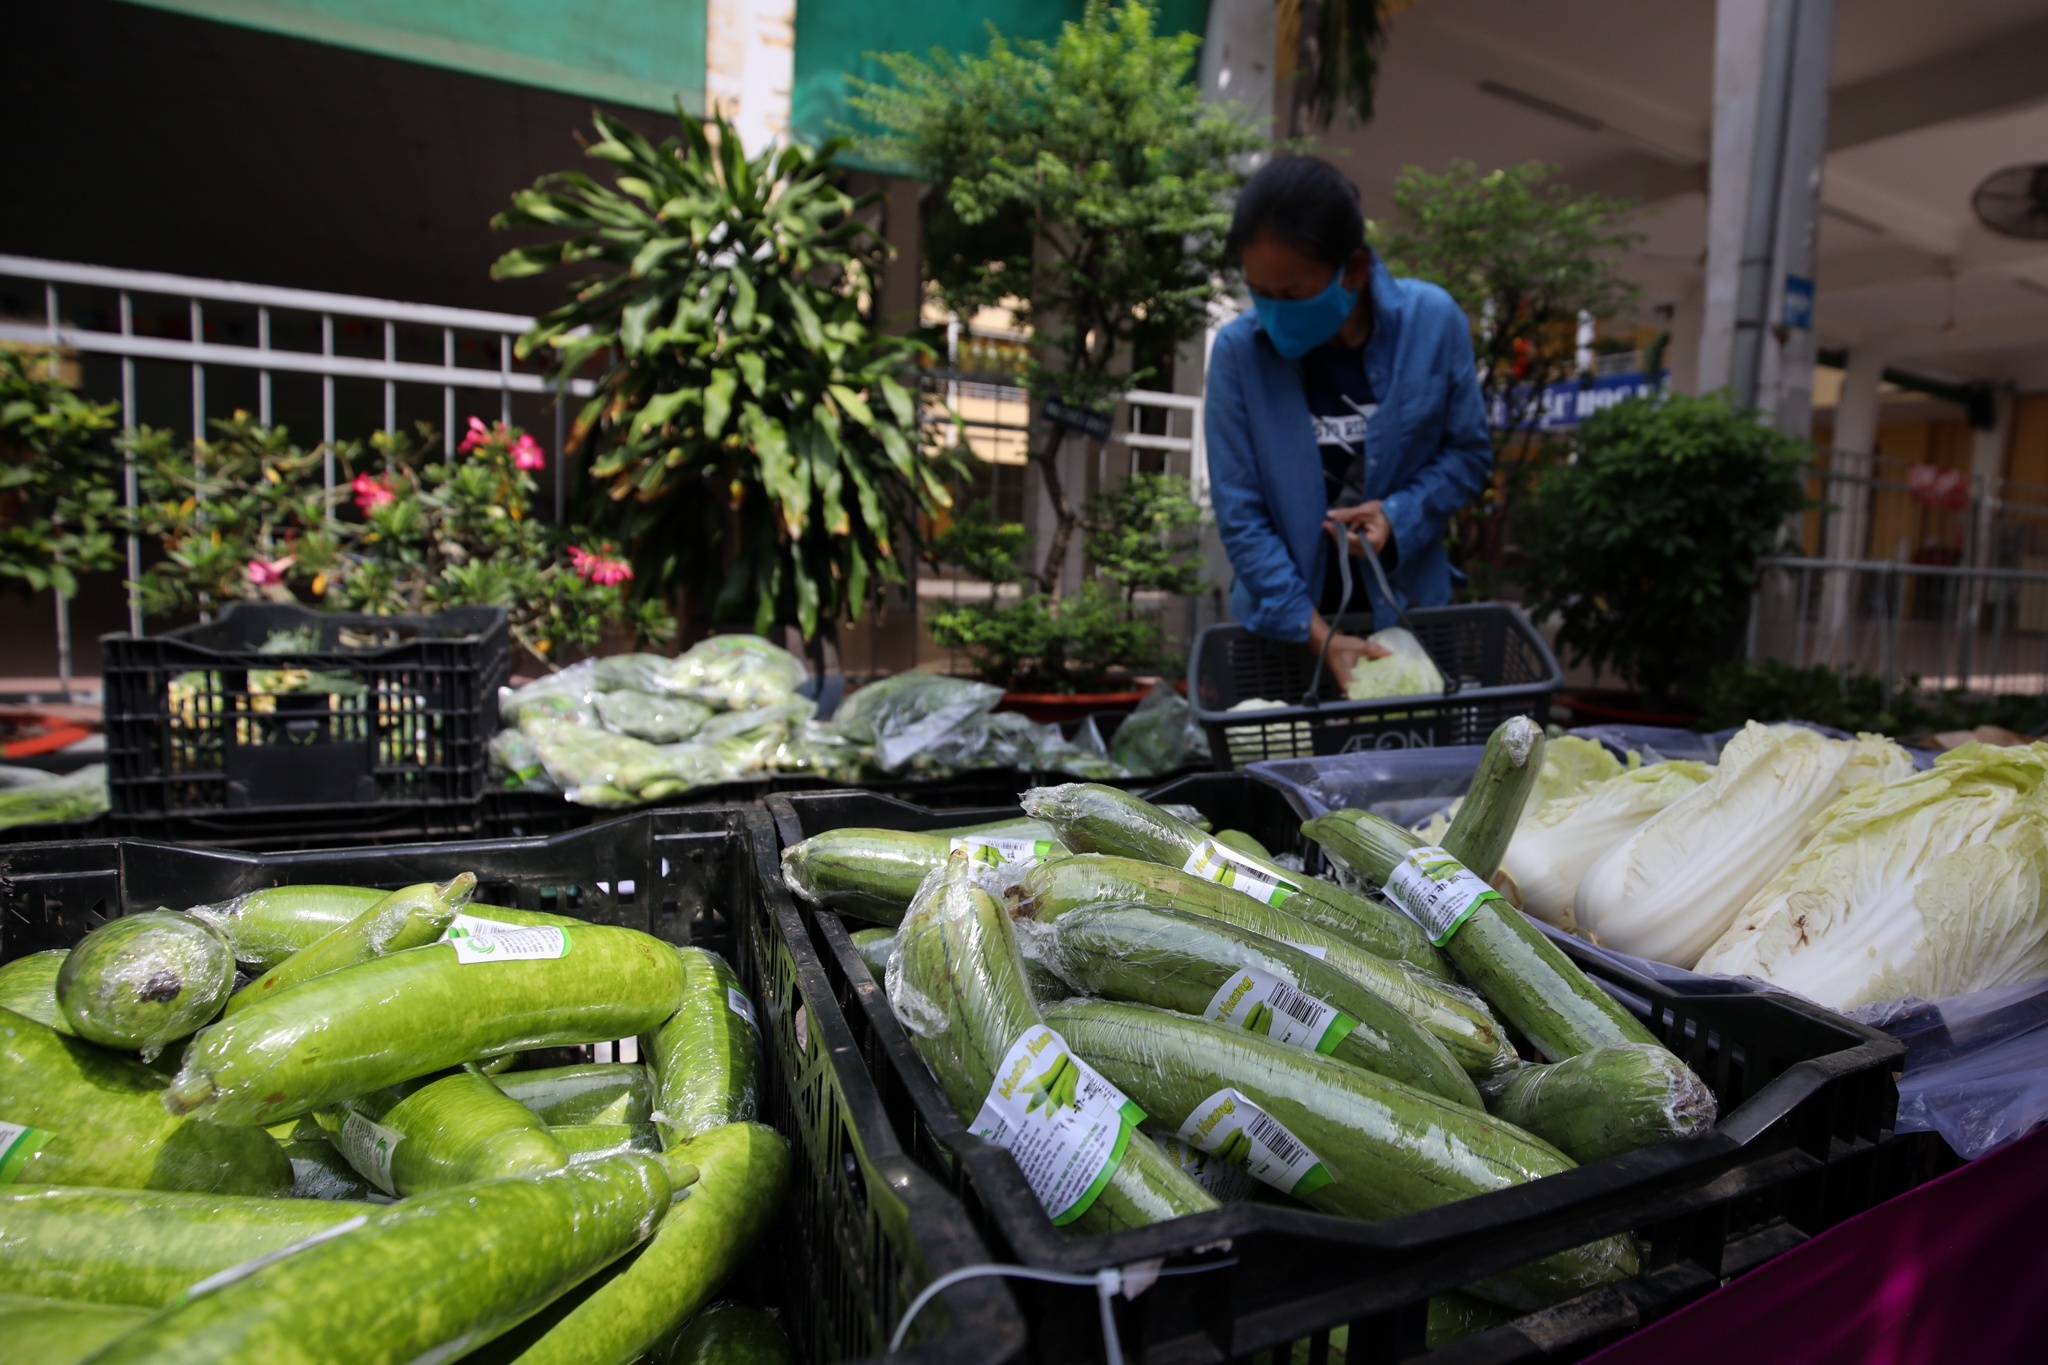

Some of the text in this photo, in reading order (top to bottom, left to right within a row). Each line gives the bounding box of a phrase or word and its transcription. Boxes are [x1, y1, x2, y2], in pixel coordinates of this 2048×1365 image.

[1218, 975, 1254, 1016] Hương
[998, 1052, 1032, 1100] Mướp
[1196, 1096, 1237, 1138] Hương
